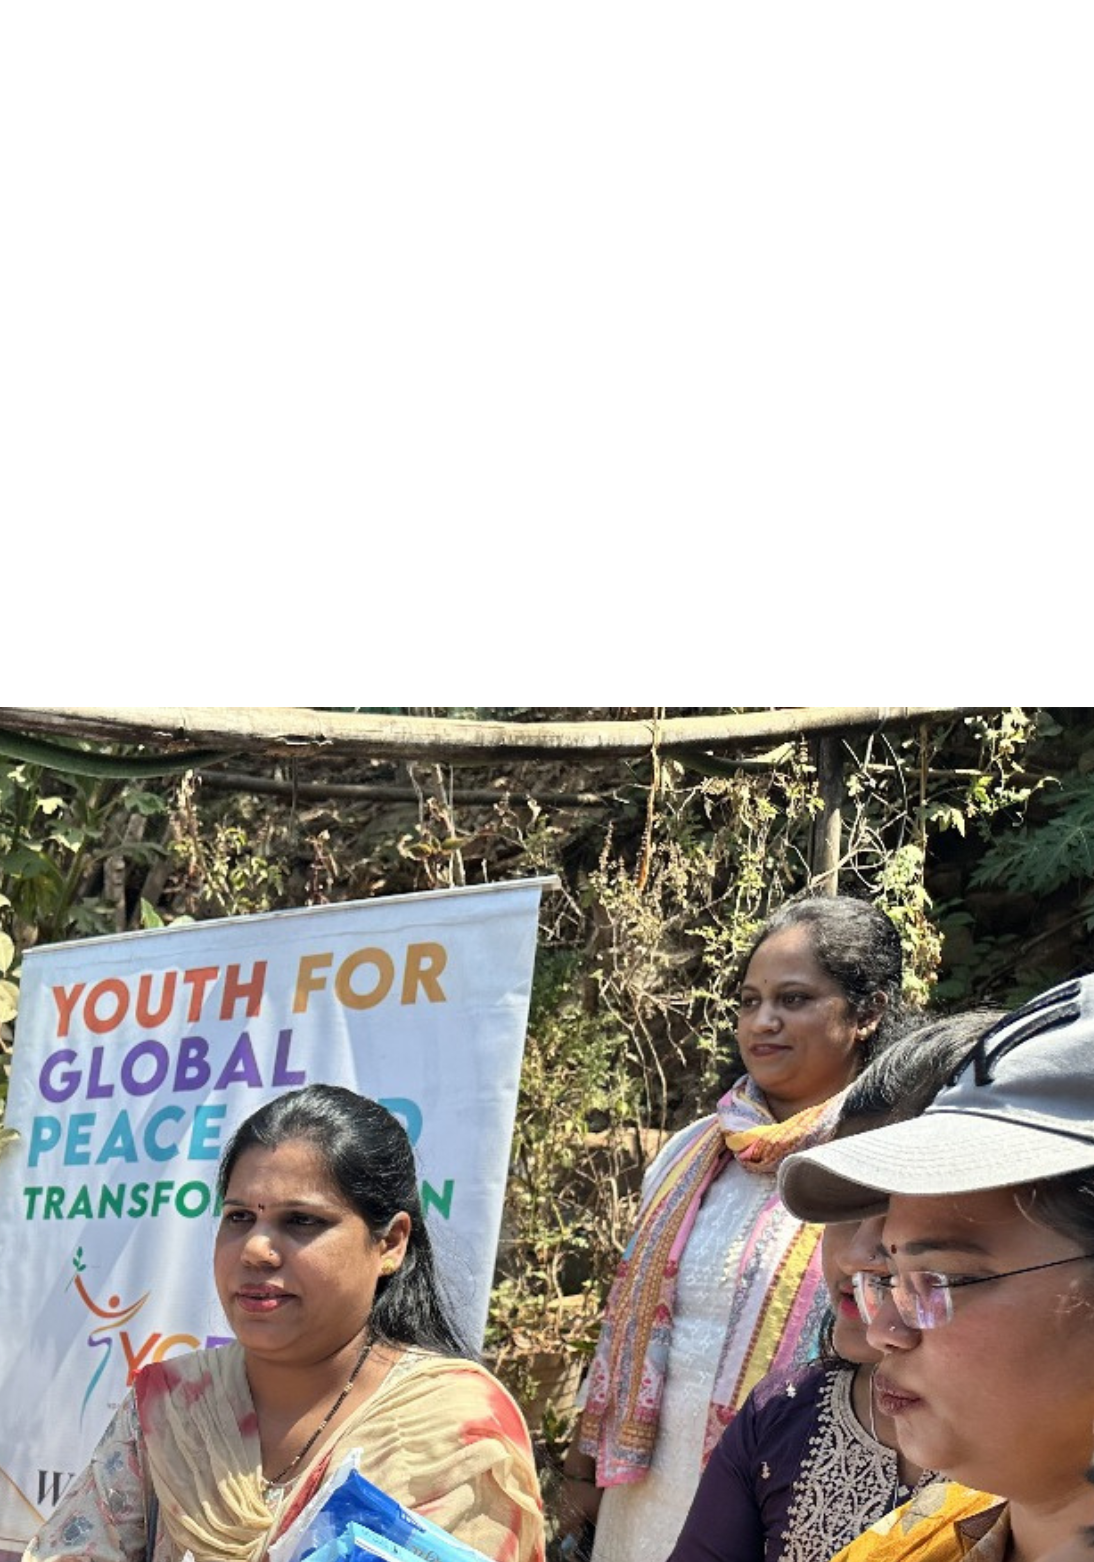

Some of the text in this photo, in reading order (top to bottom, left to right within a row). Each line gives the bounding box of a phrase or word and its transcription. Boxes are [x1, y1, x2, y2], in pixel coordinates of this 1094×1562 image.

[52, 942, 448, 1037] YOUTH FOR
[39, 1029, 306, 1103] GLOBAL
[27, 1104, 227, 1168] PEACE
